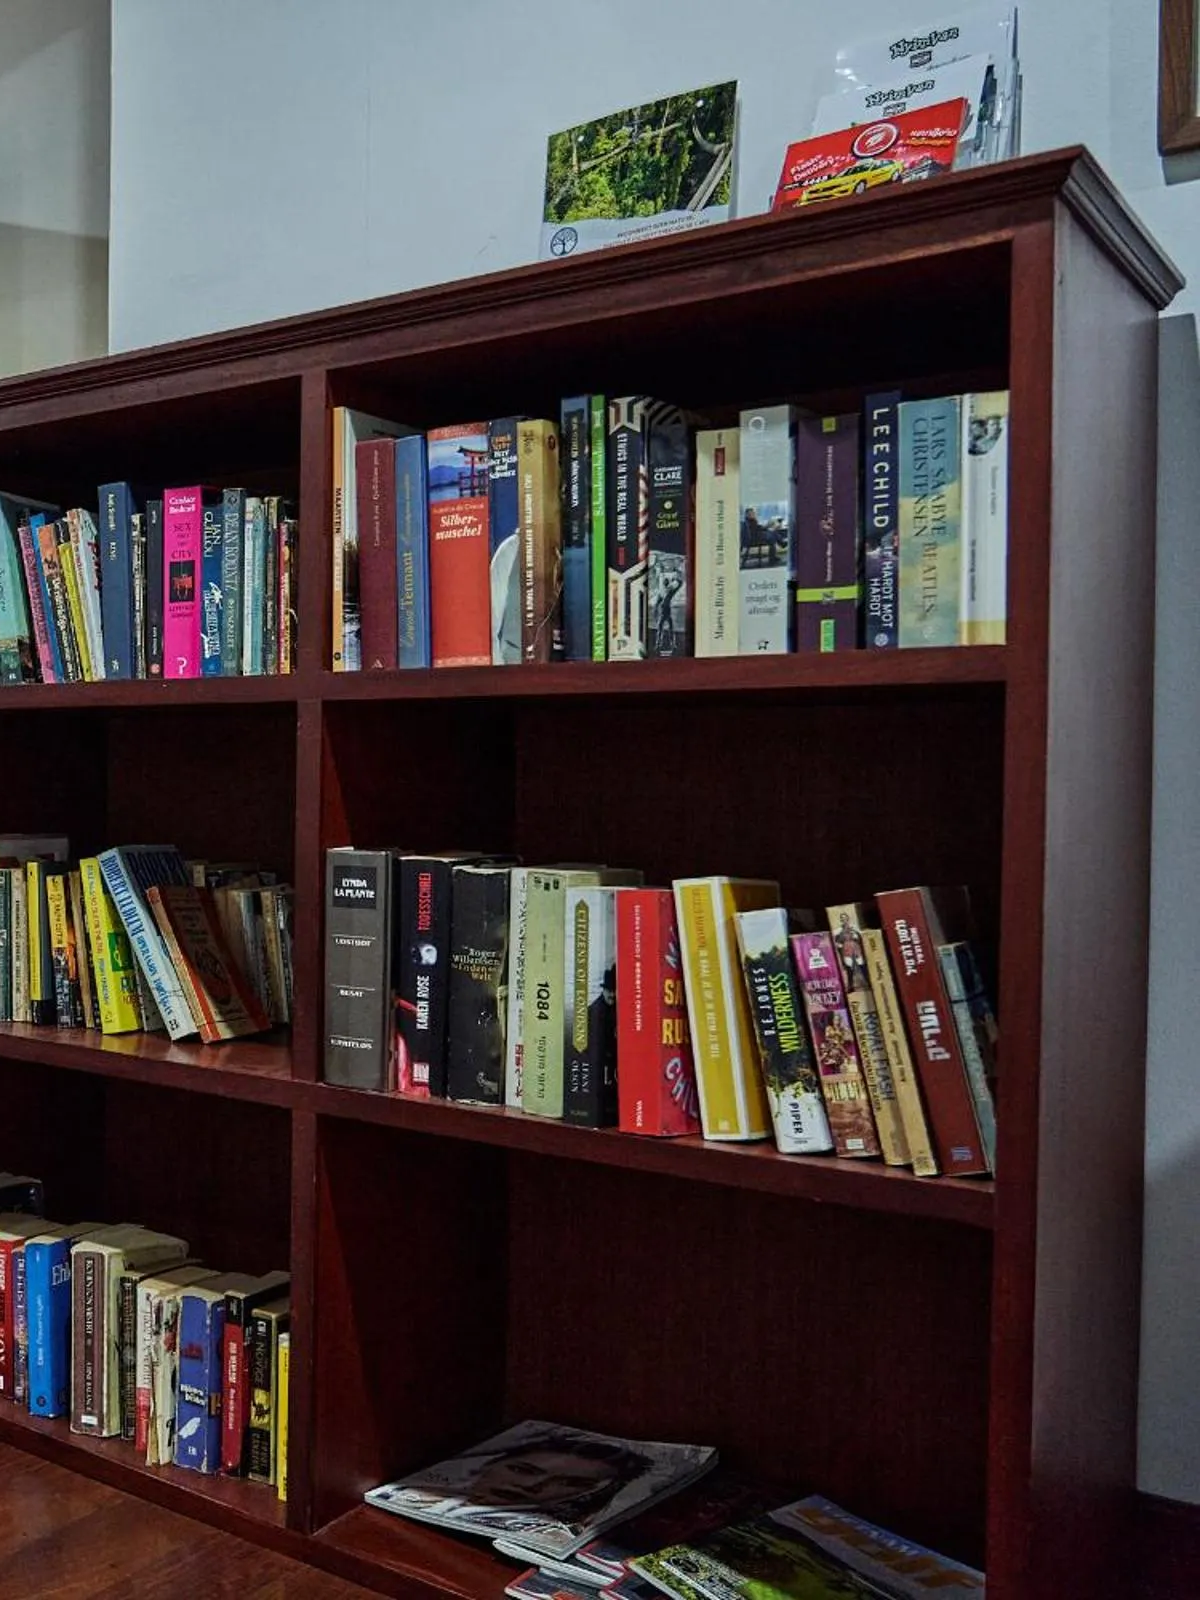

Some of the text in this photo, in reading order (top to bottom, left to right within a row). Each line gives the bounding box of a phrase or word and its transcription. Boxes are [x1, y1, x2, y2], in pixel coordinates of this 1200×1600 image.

[616, 475, 627, 490] THE
[653, 471, 682, 481] CLARE
[873, 407, 890, 528] LEE CHILD
[912, 418, 929, 538] CHRISTENSEN
[931, 415, 947, 537] LARS SAABYE
[209, 523, 221, 546] JAN
[225, 512, 240, 543] DEAN
[435, 524, 482, 541] muschel
[440, 513, 478, 527] Silber-
[225, 545, 240, 591] KOONTZ
[401, 551, 414, 609] Tennant
[922, 542, 939, 616] BEATLES
[869, 577, 882, 616] HARDT
[881, 561, 894, 628] HARDT MOT
[101, 854, 129, 897] ROBERT
[335, 888, 375, 899] LA PLANTE
[342, 877, 367, 888] LYNDA
[418, 872, 432, 931] TODESSCHREI
[575, 908, 587, 1043] CITIZENS OF LONDON
[753, 967, 771, 1009] JONES
[416, 975, 429, 1030] KAREN ROSE
[537, 981, 549, 1020] 1Q84
[768, 972, 801, 1054] WILDERNESS
[863, 1010, 894, 1102] ROYAL FLASH
[789, 1102, 803, 1134] PIPER
